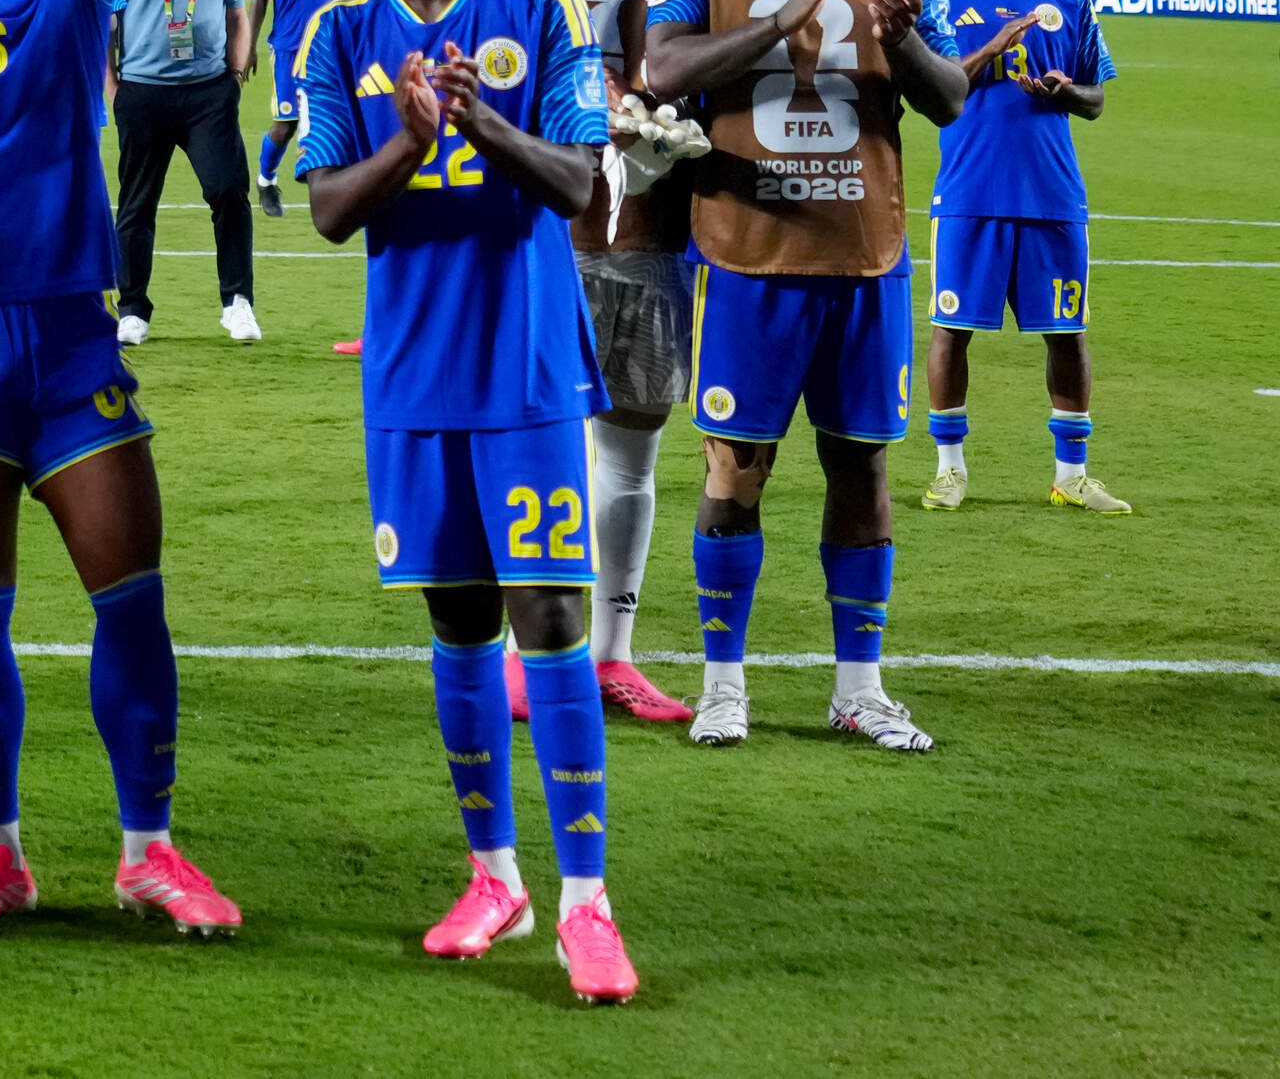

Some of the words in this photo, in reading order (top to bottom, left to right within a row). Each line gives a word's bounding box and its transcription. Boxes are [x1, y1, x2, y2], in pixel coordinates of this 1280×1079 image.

[995, 42, 1028, 81] 13
[784, 120, 834, 138] FIFA
[755, 159, 824, 175] WORLD
[826, 159, 863, 175] CUP
[755, 177, 865, 201] 2026
[1052, 279, 1082, 319] 13
[507, 486, 583, 559] 22
